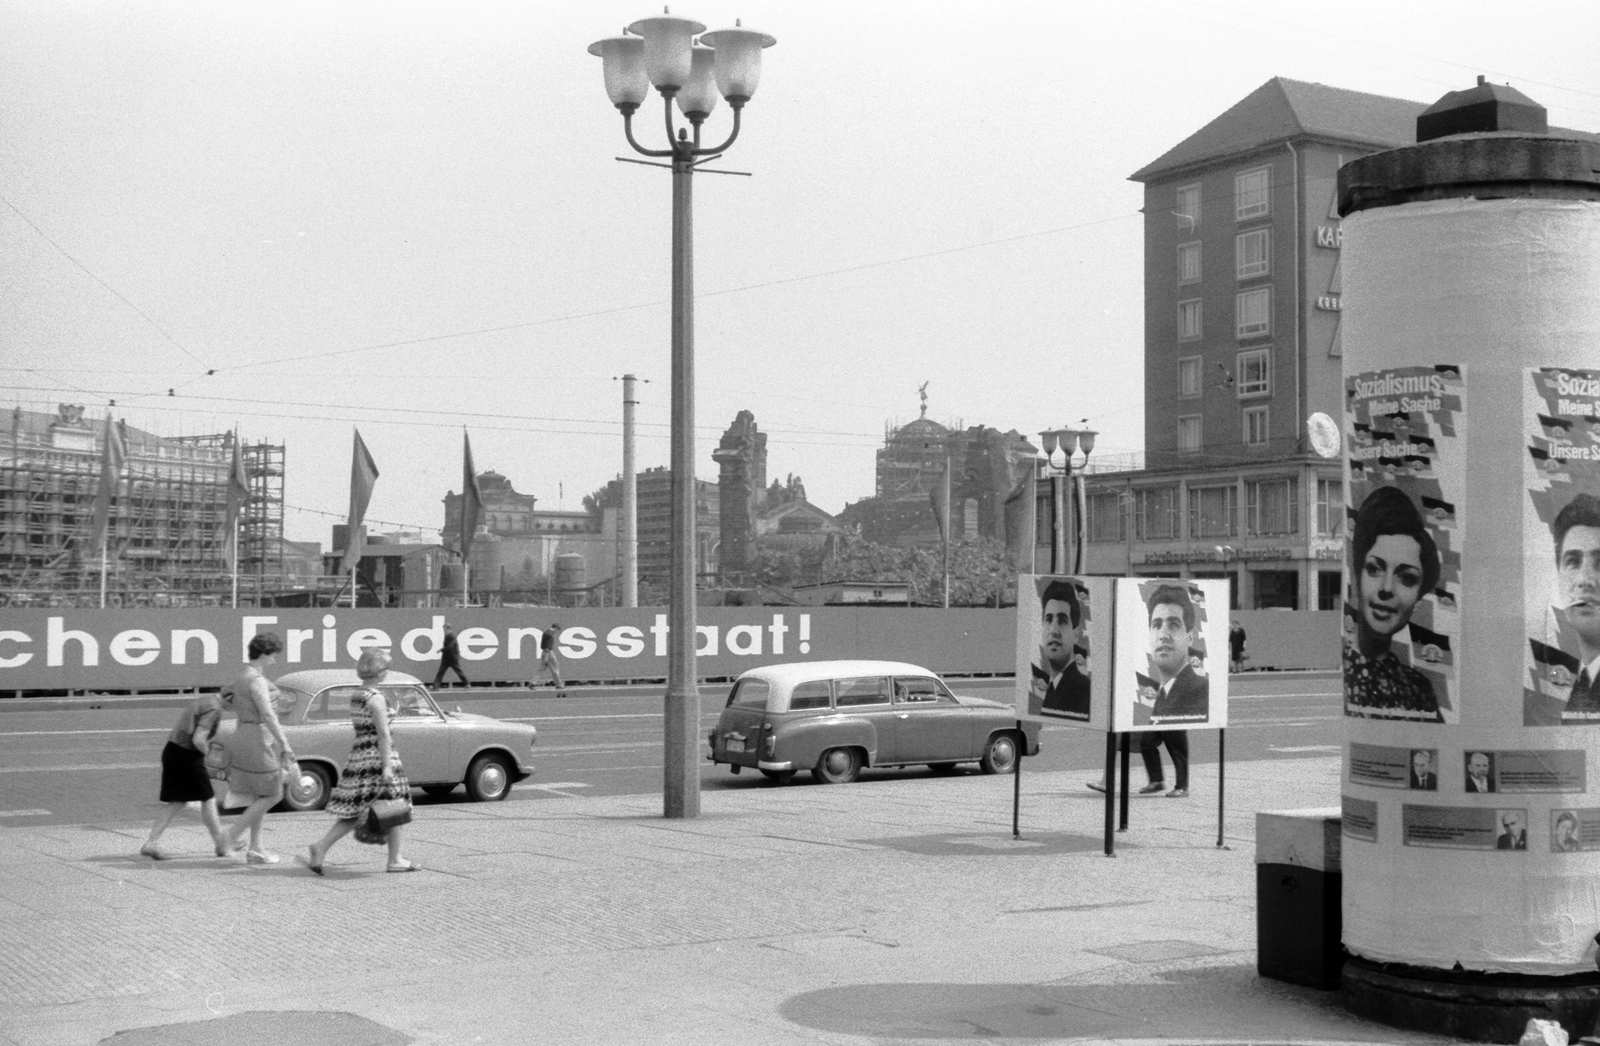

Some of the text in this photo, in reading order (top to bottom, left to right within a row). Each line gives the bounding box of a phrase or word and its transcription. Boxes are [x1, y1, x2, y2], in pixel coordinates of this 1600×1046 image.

[1355, 373, 1440, 399] Sozialismus
[1368, 396, 1441, 416] Meine Sache
[1558, 399, 1593, 415] Meine
[1381, 441, 1418, 458] Sache
[1548, 442, 1589, 459] Unsere
[242, 613, 811, 664] Friedensstaat!
